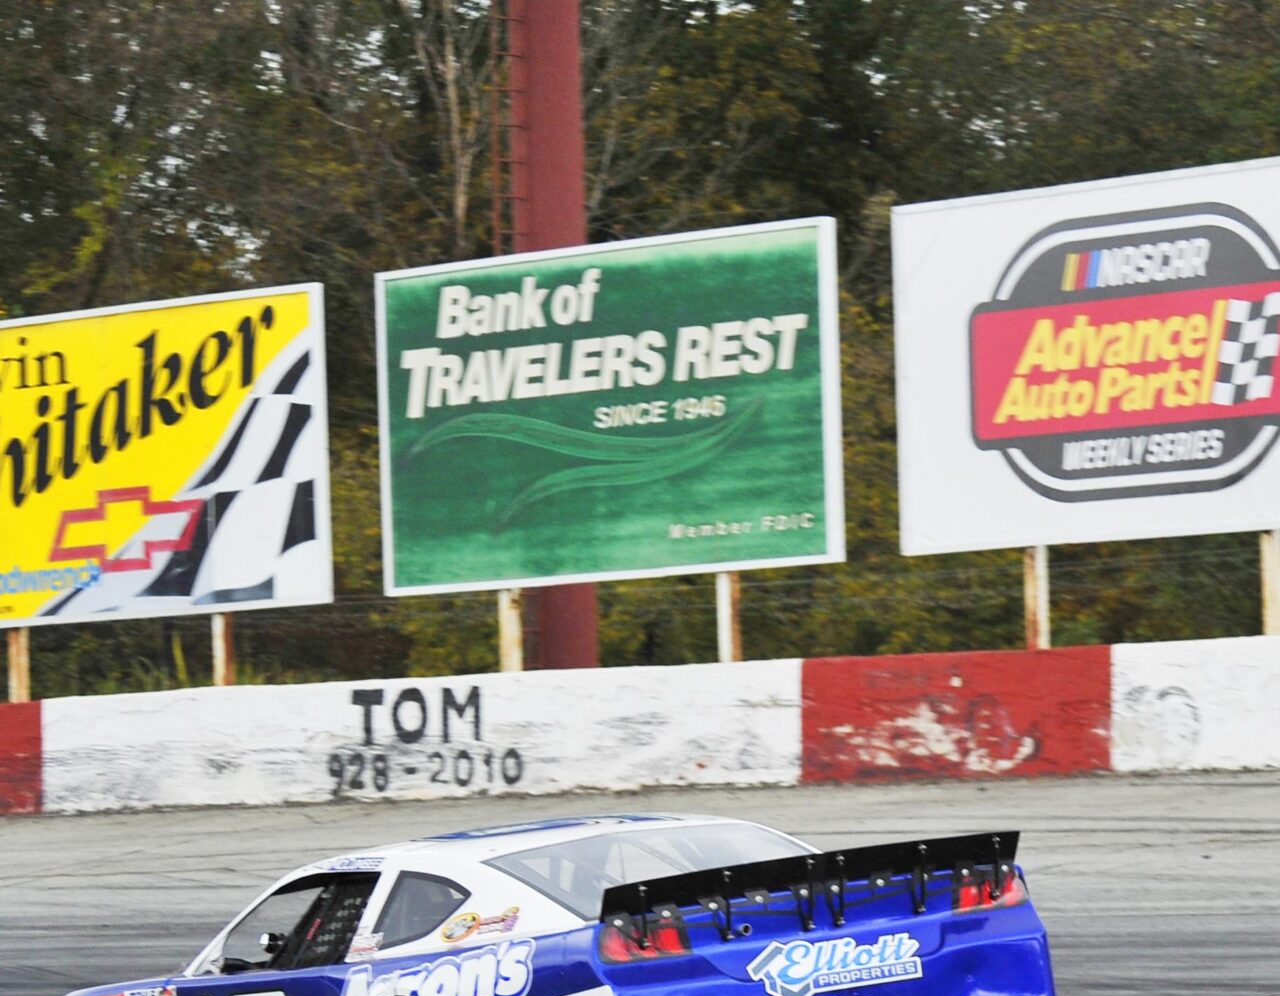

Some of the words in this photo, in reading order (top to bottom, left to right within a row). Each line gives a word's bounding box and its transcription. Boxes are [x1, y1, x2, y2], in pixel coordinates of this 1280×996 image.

[1096, 238, 1211, 288] NASCAR
[435, 276, 550, 339] Bank
[551, 268, 602, 325] of
[400, 331, 668, 419] TRAVELERS
[672, 313, 809, 382] REST
[1012, 311, 1208, 375] Advance
[593, 400, 667, 429] SINCE
[991, 377, 1094, 424] Auto
[1095, 367, 1202, 415] Parts
[1061, 435, 1146, 471] WEEKLY
[1146, 430, 1226, 465] SERIES
[667, 520, 753, 540] Member
[760, 512, 816, 533] FDIC
[352, 686, 481, 745] TOM
[779, 932, 920, 985] Elliott
[818, 962, 917, 987] PROPERTIES
